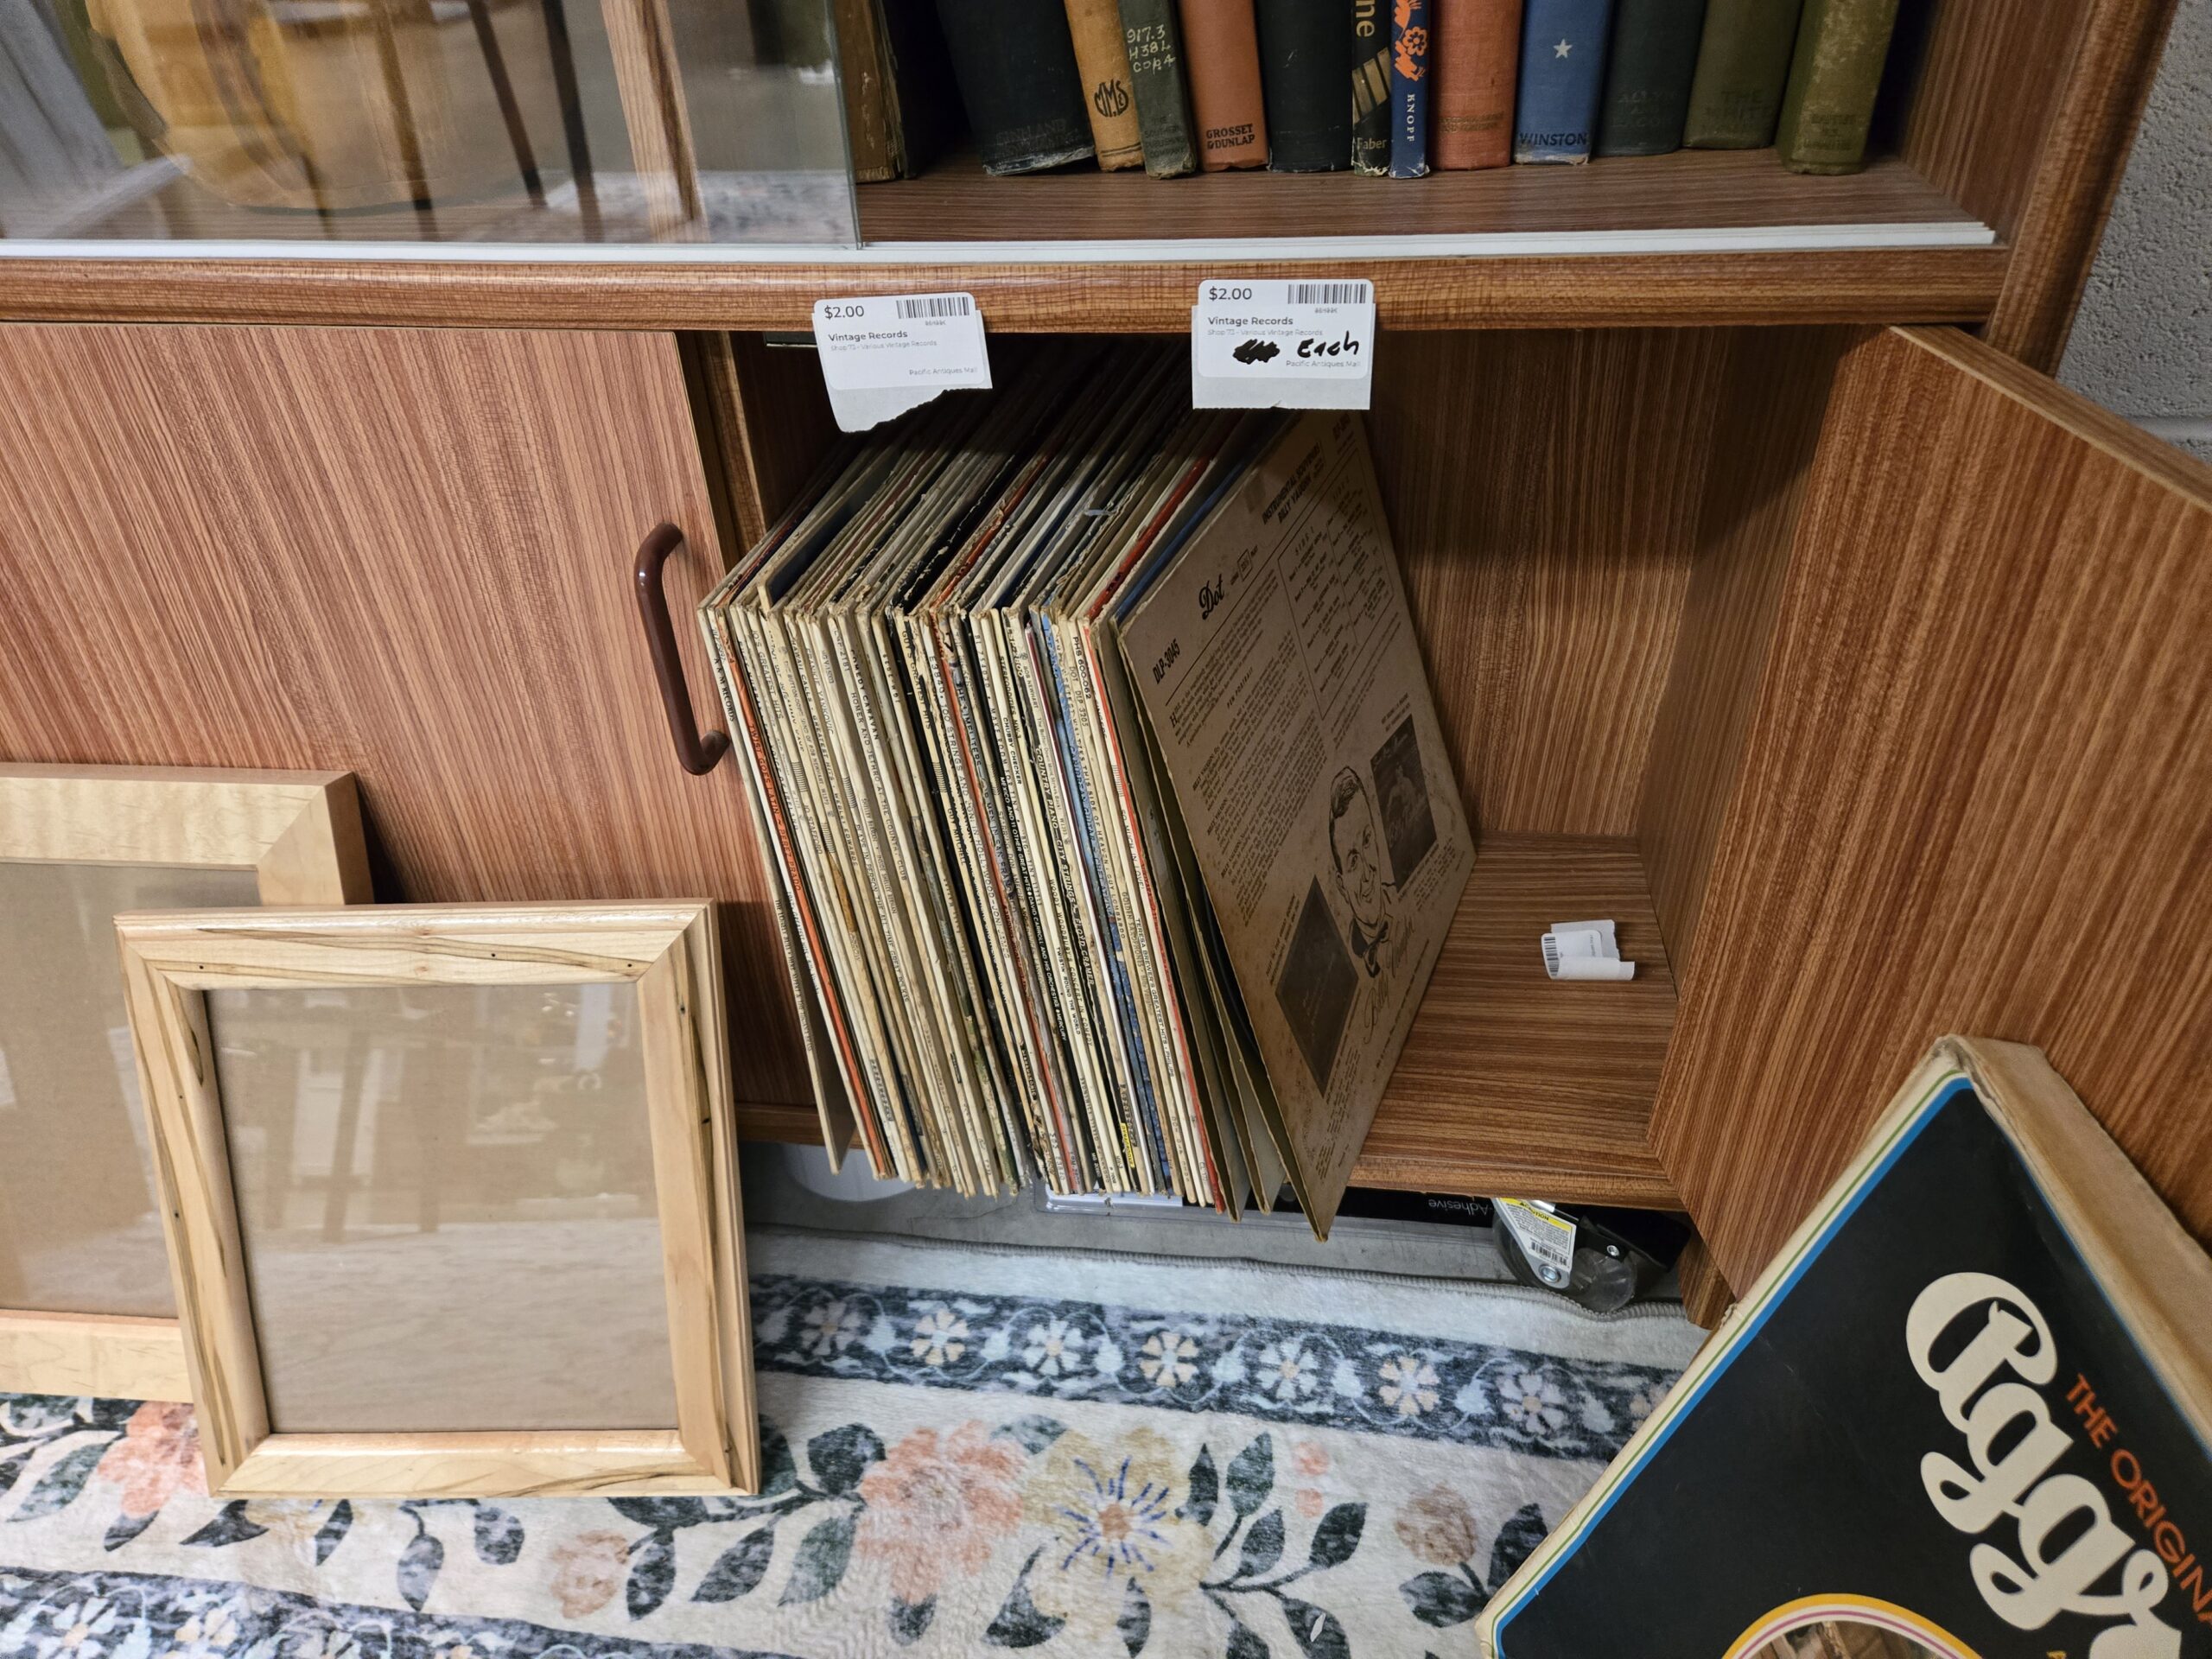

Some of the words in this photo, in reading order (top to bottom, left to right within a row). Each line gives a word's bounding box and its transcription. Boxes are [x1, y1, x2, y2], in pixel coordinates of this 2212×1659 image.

[1127, 24, 1166, 43] 917.3
[1206, 124, 1253, 138] GROSSET
[1357, 137, 1386, 150] Faber
[1520, 132, 1587, 146] WINSTON
[824, 305, 864, 320] $2.00
[1209, 287, 1252, 302] $2.00
[829, 333, 866, 342] Vintage
[1208, 317, 1248, 327] Vintage
[1198, 575, 1226, 620] Dot
[1071, 636, 1082, 656] PHS
[1152, 638, 1181, 684] DLP-3045
[1068, 666, 1078, 683] DOT
[1074, 690, 1084, 707] DLP
[1076, 658, 1092, 699] 600-062
[721, 686, 736, 722] RECORDS
[799, 673, 812, 702] CALLS
[811, 714, 829, 758] GREATEST
[861, 694, 880, 741] CARAVAN
[757, 650, 776, 696] GREATEST
[772, 698, 784, 720] HITS
[806, 815, 823, 855] STAFFORD
[850, 691, 865, 725] HOMER
[860, 727, 870, 747] AND
[866, 748, 880, 783] JETHRO
[880, 798, 889, 816] THE
[896, 859, 907, 881] CLUB
[945, 725, 963, 772] STRINGS
[958, 774, 969, 794] AND
[971, 824, 980, 836] IN
[1081, 766, 1091, 787] THIS
[747, 722, 763, 754] TWIST
[757, 756, 772, 785] GOES
[766, 786, 780, 815] LATIN
[778, 828, 792, 859] PEREZ
[787, 860, 802, 892] PRADO
[1087, 790, 1096, 812] SIDE
[1092, 815, 1100, 828] OF
[1001, 716, 1014, 748] CHUBBY
[1008, 750, 1023, 785] CHECKER
[1062, 976, 1071, 997] ROUND
[1071, 1013, 1081, 1035] WORLD
[1033, 747, 1052, 796] COUNTRY
[1060, 863, 1076, 903] STRINGS
[1080, 949, 1095, 986] CRAMER
[1105, 874, 1115, 891] GUY
[998, 776, 1011, 804] MEXICO
[1005, 804, 1014, 821] AND
[1011, 828, 1022, 852] OTHER
[1017, 852, 1027, 876] GREAT
[1027, 895, 1037, 916] DAVID
[1032, 916, 1044, 944] CARROLL
[1039, 945, 1047, 960] AND
[1045, 971, 1058, 1007] ORCHESTRA
[1054, 1013, 1067, 1041] MERCURY
[1048, 878, 1060, 908] WOODY
[1121, 891, 1134, 920] GOLDEN
[1109, 893, 1126, 939] LOMBARDO
[1068, 966, 1083, 1003] CONCERT
[1134, 918, 1147, 948] TERESA
[1141, 950, 1156, 988] BREWER'S
[1150, 988, 1165, 1027] GREATEST
[1160, 1027, 1168, 1044] HITS
[1077, 1004, 1084, 1014] IN
[1080, 1016, 1092, 1047] COMEDY
[2065, 1373, 2119, 1450] THE
